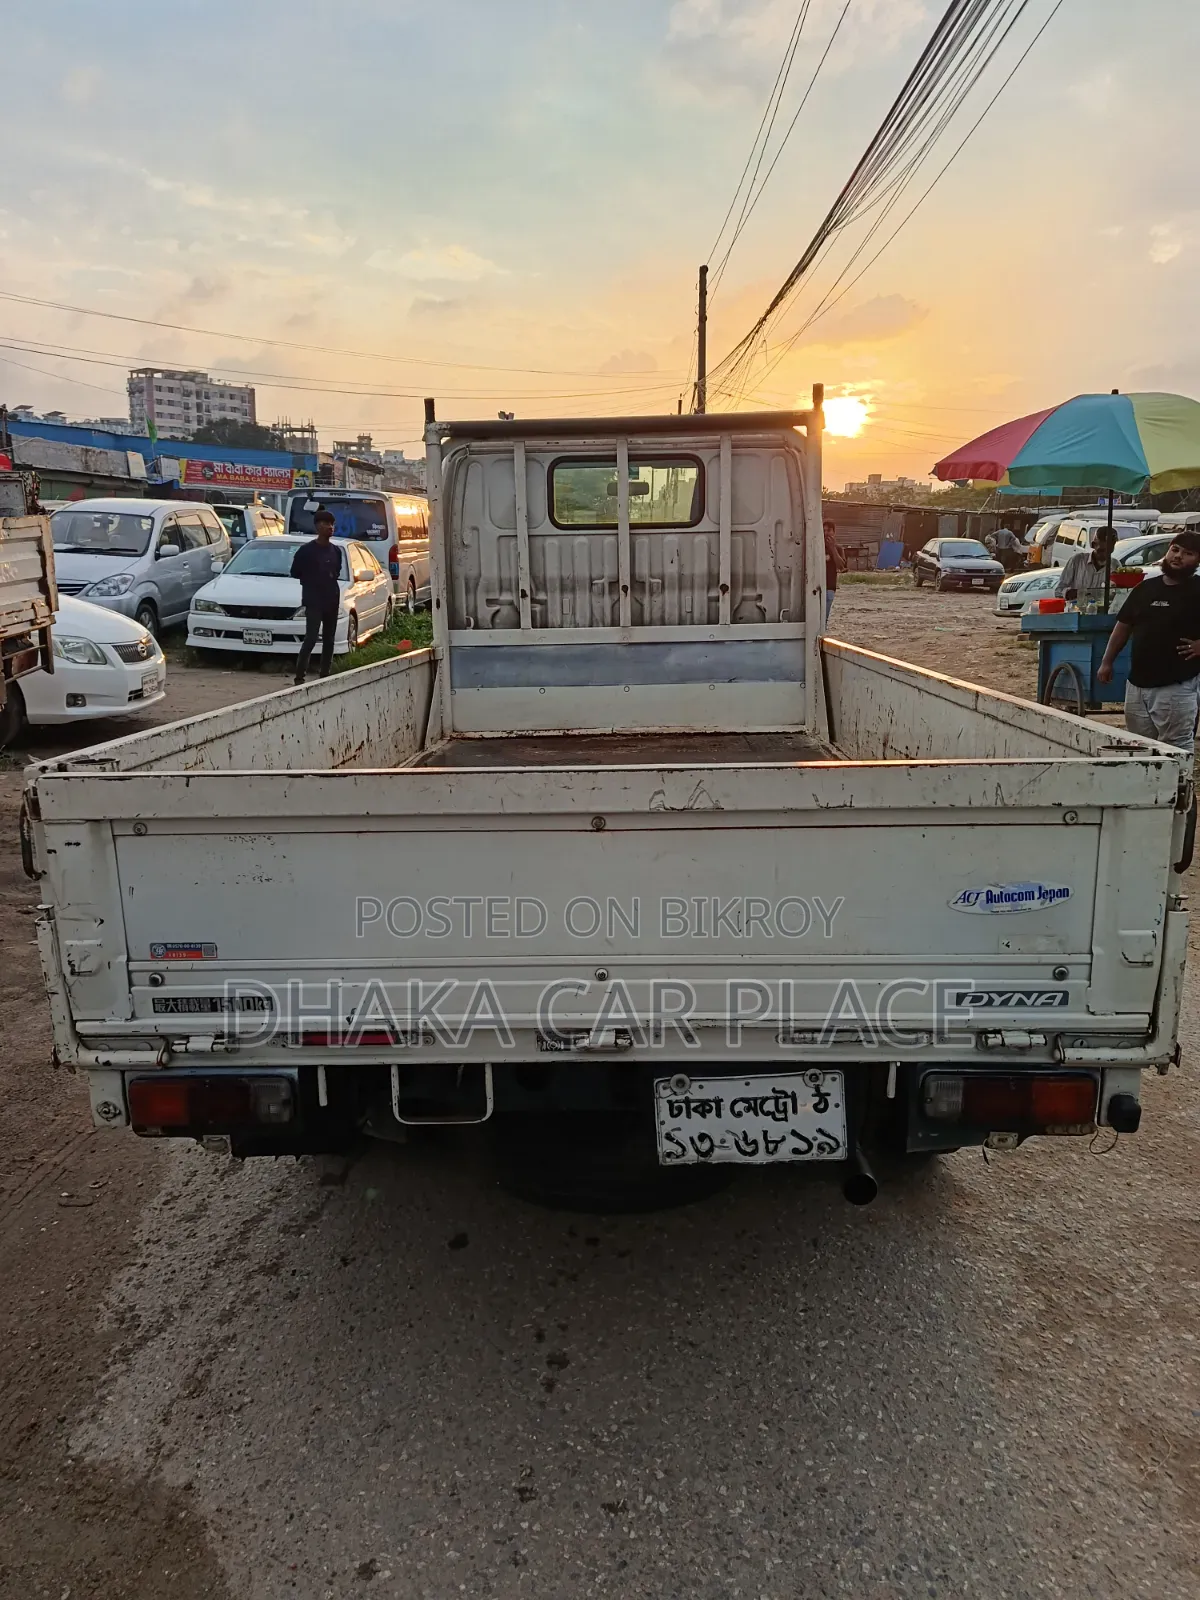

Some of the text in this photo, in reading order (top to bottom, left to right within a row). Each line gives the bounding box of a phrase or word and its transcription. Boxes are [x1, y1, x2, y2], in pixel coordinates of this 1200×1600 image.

[213, 462, 224, 473] মা
[244, 465, 262, 476] কার
[263, 467, 291, 479] প্যালেস
[229, 474, 250, 482] BABA
[251, 475, 266, 483] CAR
[986, 889, 1035, 904] Autocom
[1037, 885, 1070, 903] Japan
[960, 992, 1063, 1006] DYNA
[667, 1095, 724, 1119] ঢাকা
[730, 1087, 798, 1122] মেট্রো
